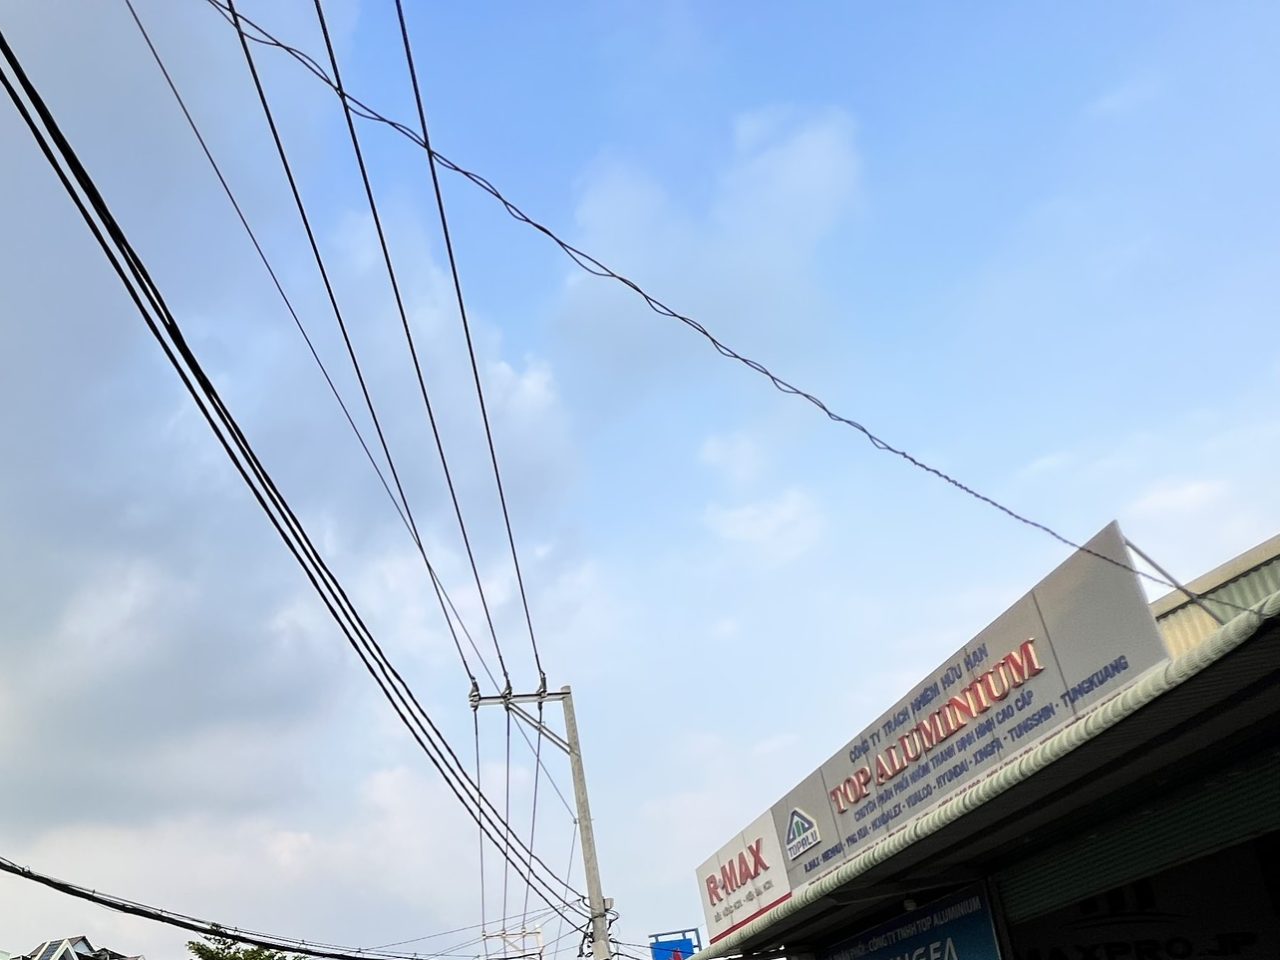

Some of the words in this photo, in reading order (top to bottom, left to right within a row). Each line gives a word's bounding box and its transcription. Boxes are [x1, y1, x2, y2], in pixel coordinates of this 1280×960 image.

[996, 703, 1014, 725] CAO
[1007, 702, 1056, 742] TUNGSHIN
[1060, 655, 1129, 708] TUNGKUANG
[830, 766, 871, 814] TOP
[876, 638, 1044, 787] ALUMINIUM
[870, 730, 881, 747] TY
[882, 707, 910, 736] TRÁCH
[788, 830, 818, 858] TOPALU
[917, 917, 933, 934] TOP
[933, 895, 981, 927] ALUMINIUM
